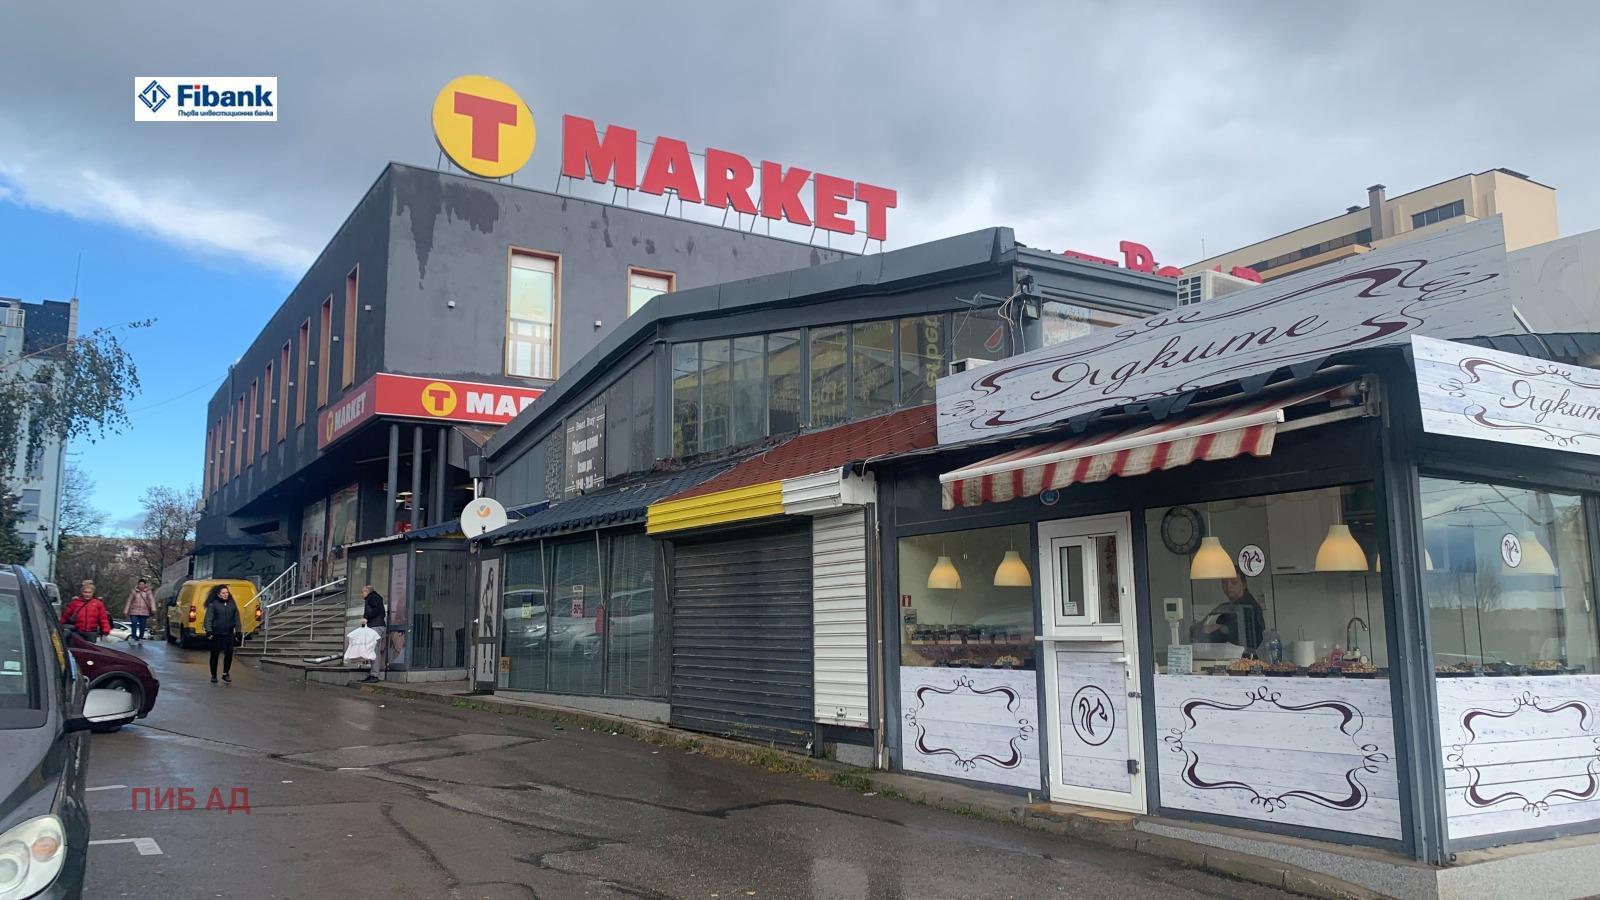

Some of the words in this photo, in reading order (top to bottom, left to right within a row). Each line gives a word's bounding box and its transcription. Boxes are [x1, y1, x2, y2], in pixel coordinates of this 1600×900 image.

[454, 91, 517, 163] T
[562, 114, 897, 241] MARKET
[334, 391, 367, 432] MARKET
[429, 389, 451, 411] T
[1500, 379, 1600, 423] Ядкит
